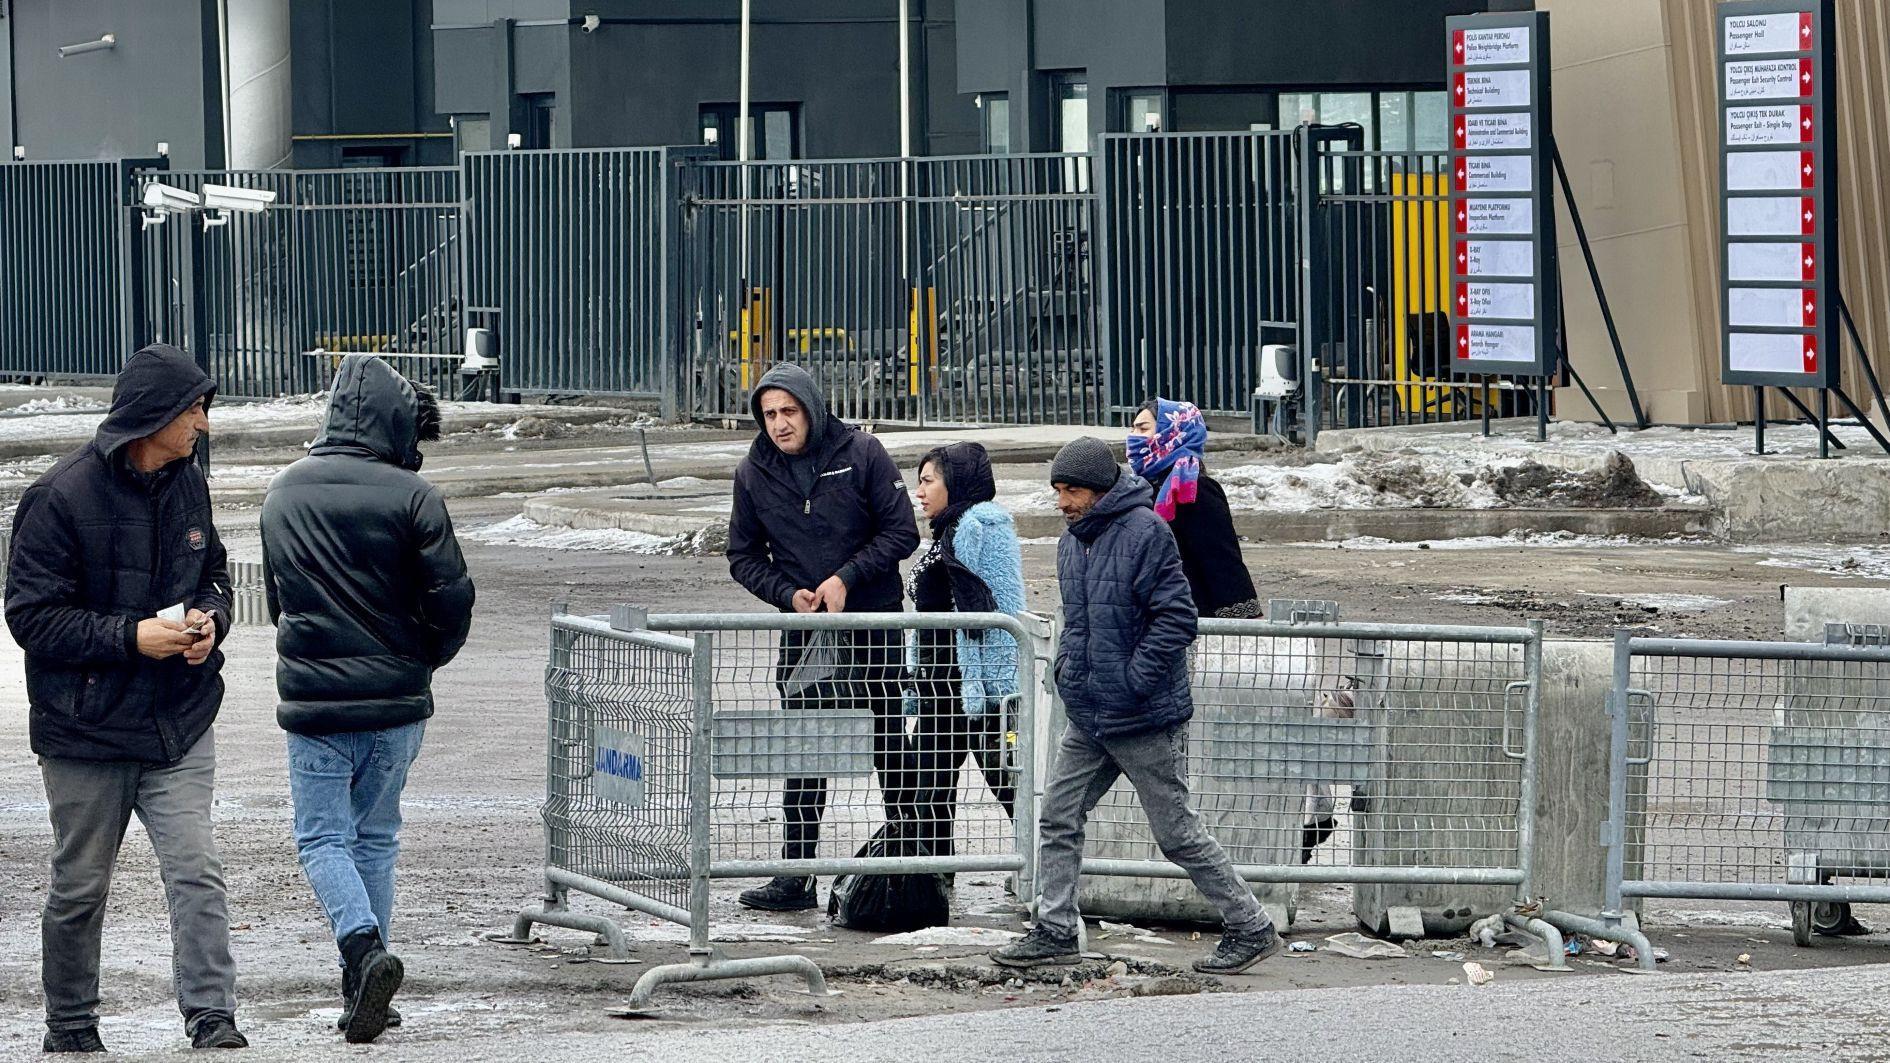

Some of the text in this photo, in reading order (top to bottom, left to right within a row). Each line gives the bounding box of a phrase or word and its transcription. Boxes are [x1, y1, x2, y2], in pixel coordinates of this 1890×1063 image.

[1730, 32, 1753, 40] Passenger
[1730, 77, 1750, 85] Passenger
[1760, 75, 1776, 84] Security
[1484, 86, 1500, 95] Building
[1767, 121, 1780, 129] Single
[1782, 120, 1792, 129] Stop
[1490, 171, 1506, 180] Building
[596, 746, 642, 781] JANDARMA
